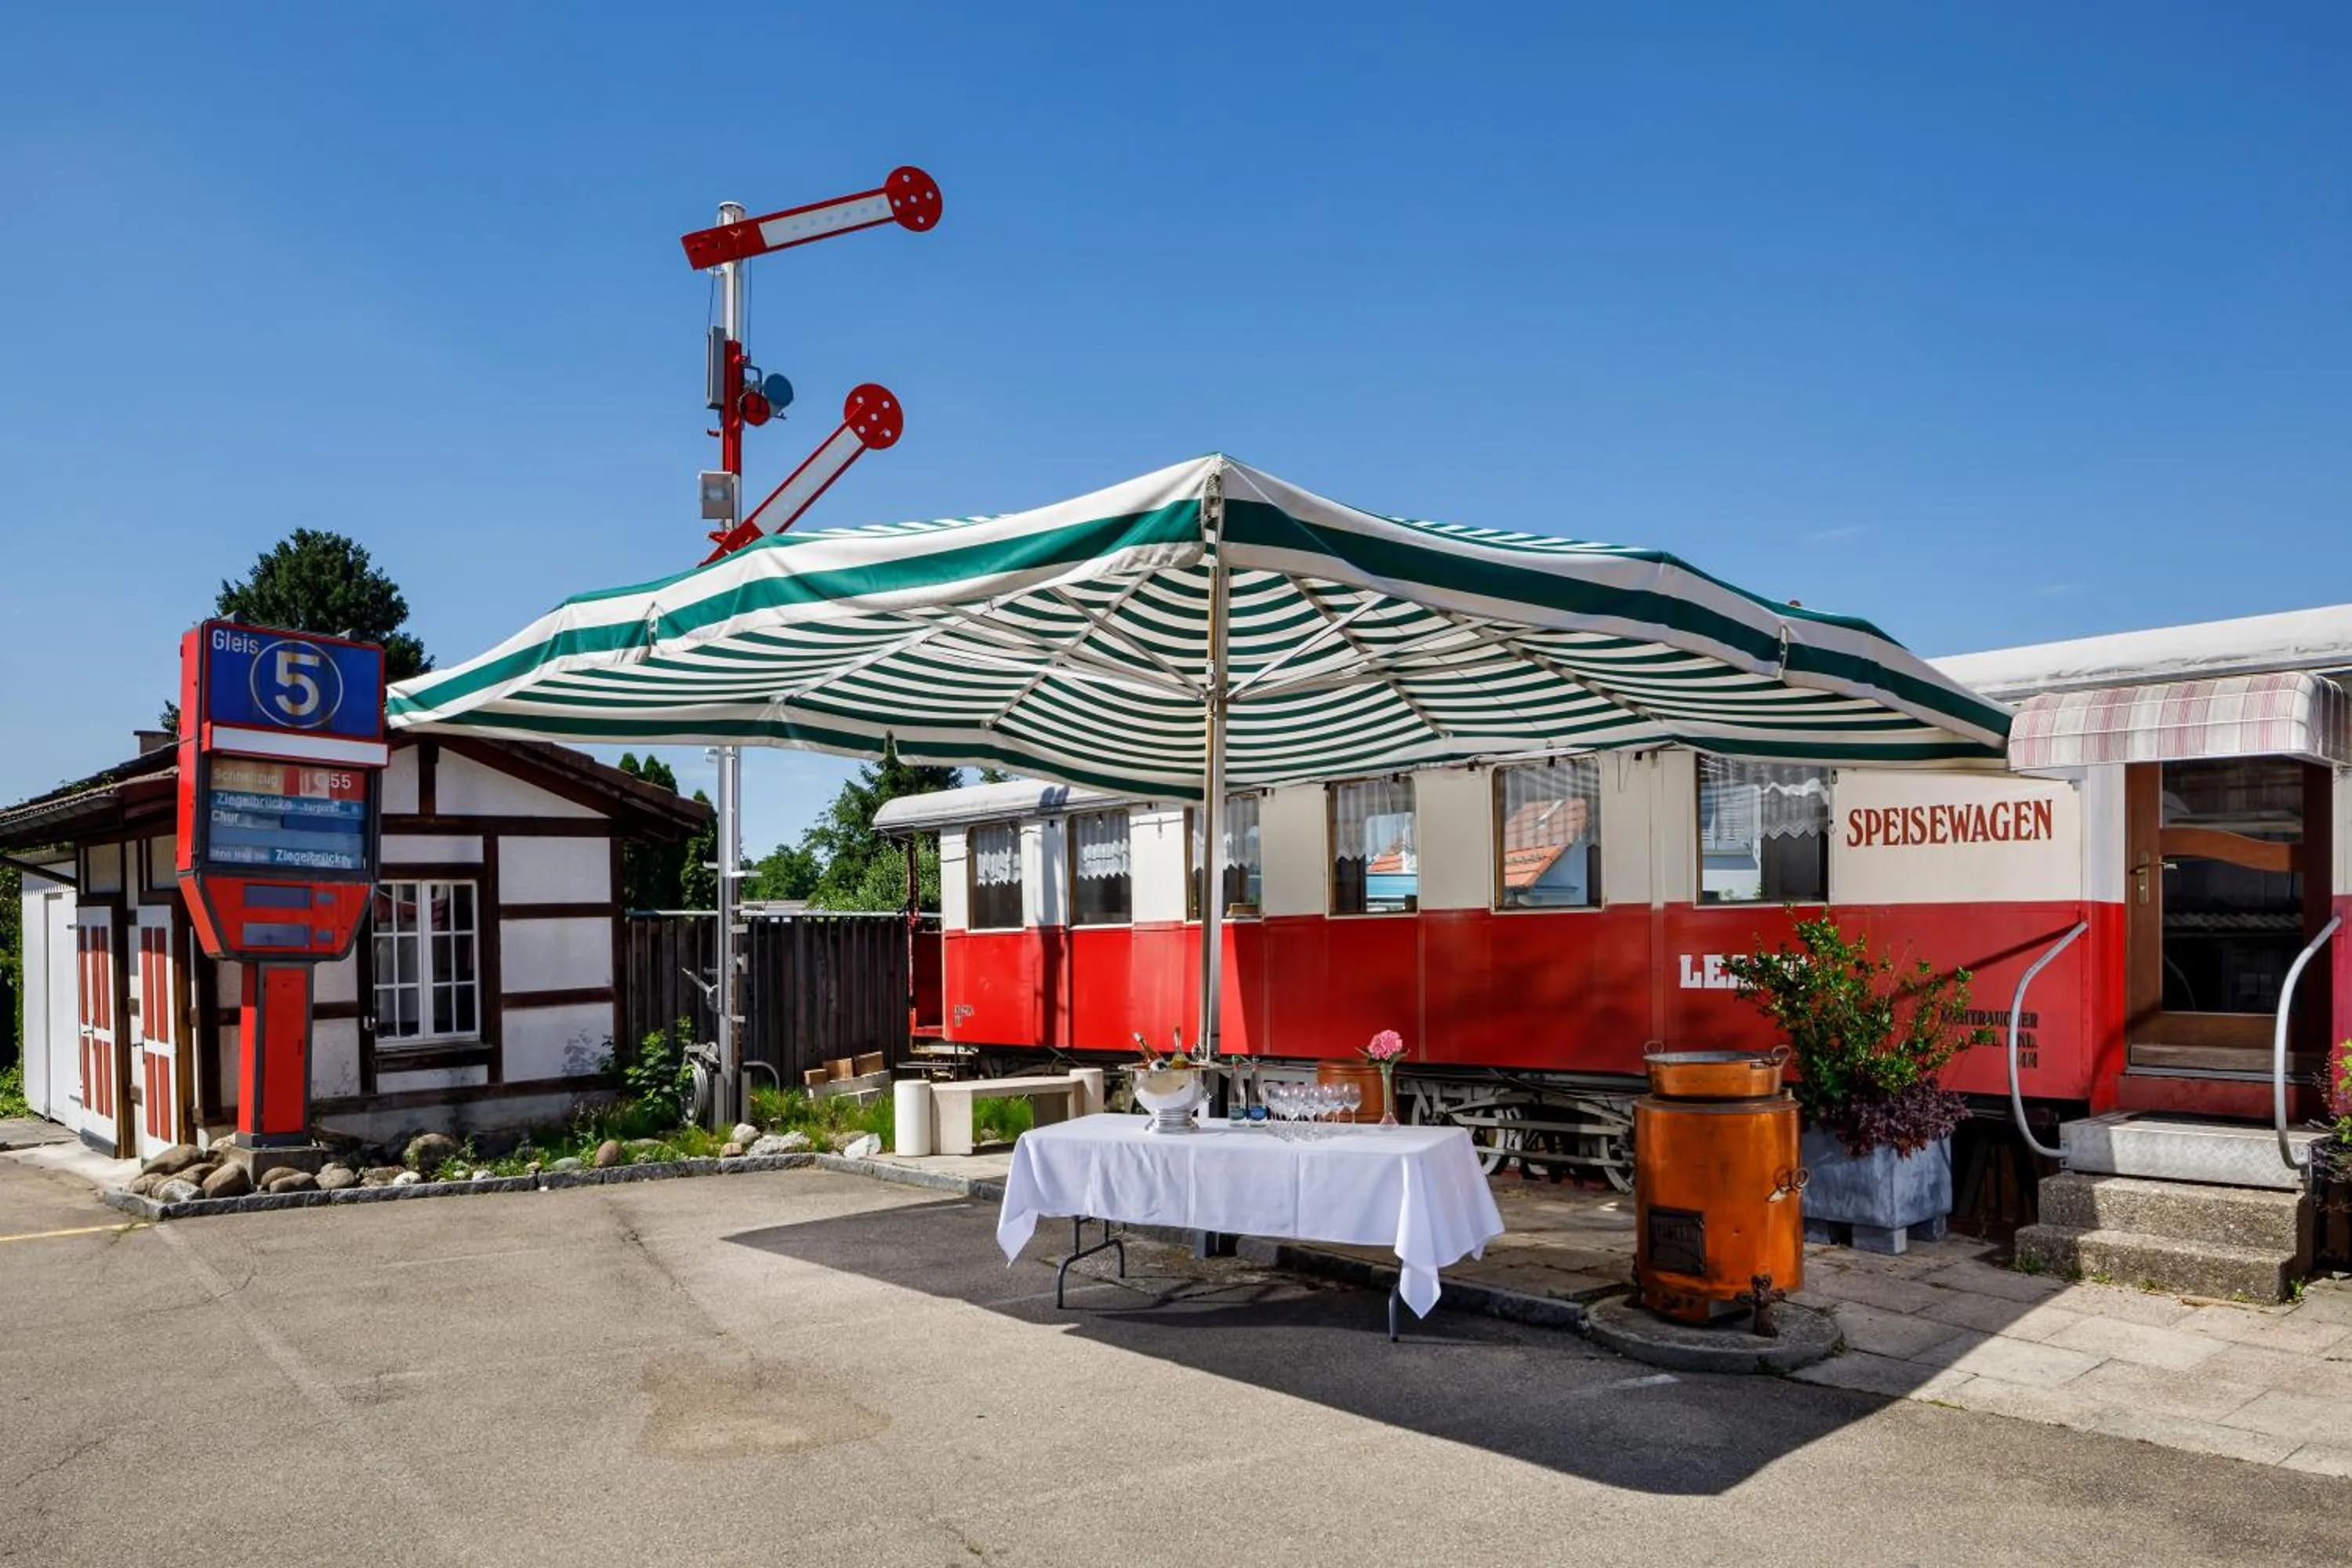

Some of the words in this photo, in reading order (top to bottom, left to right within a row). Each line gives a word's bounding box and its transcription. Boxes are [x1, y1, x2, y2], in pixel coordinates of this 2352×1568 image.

[212, 630, 260, 654] Gleis
[275, 650, 320, 717] 5
[211, 810, 239, 823] Chur
[1847, 799, 2053, 848] SPEISEWAGEN
